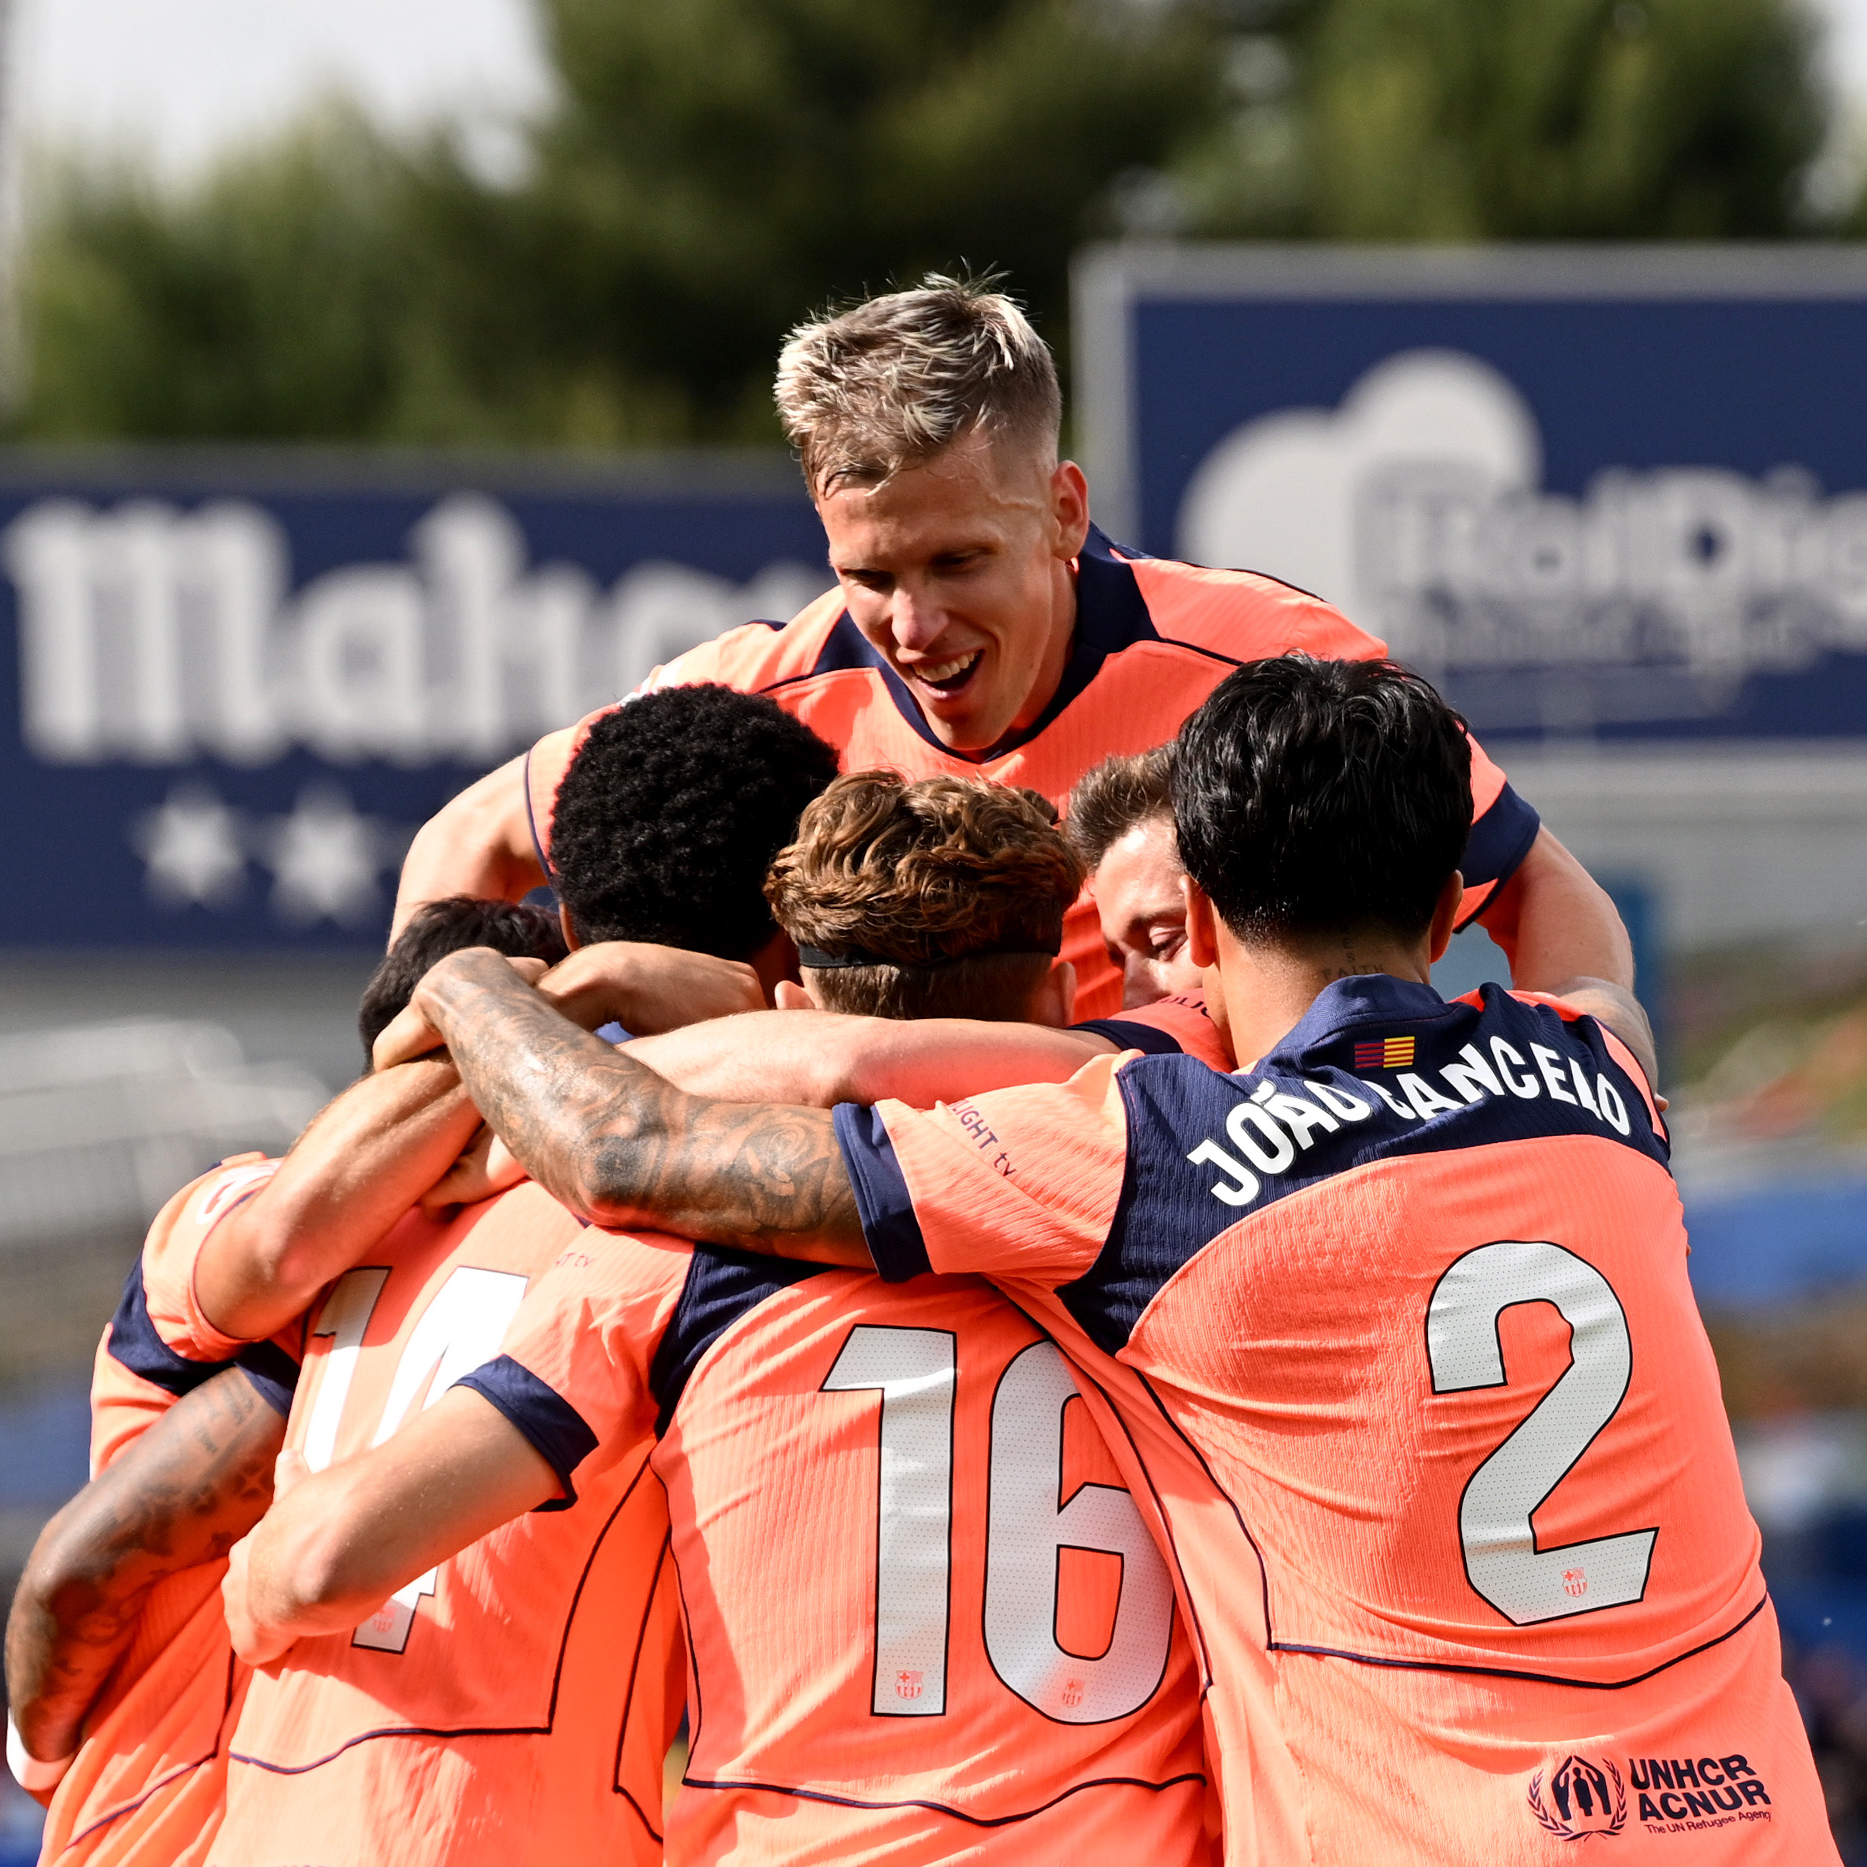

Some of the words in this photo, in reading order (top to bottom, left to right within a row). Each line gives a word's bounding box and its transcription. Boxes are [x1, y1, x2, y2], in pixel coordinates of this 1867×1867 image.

[1186, 1080, 1373, 1206] JOÃO
[1425, 1240, 1659, 1625] 2
[820, 1324, 1174, 1725] 16
[1629, 1754, 1757, 1790] UNHCR
[1639, 1779, 1772, 1821] ACNUR
[1644, 1823, 1667, 1834] The
[1666, 1822, 1686, 1833] UN
[1687, 1815, 1736, 1831] Refugee
